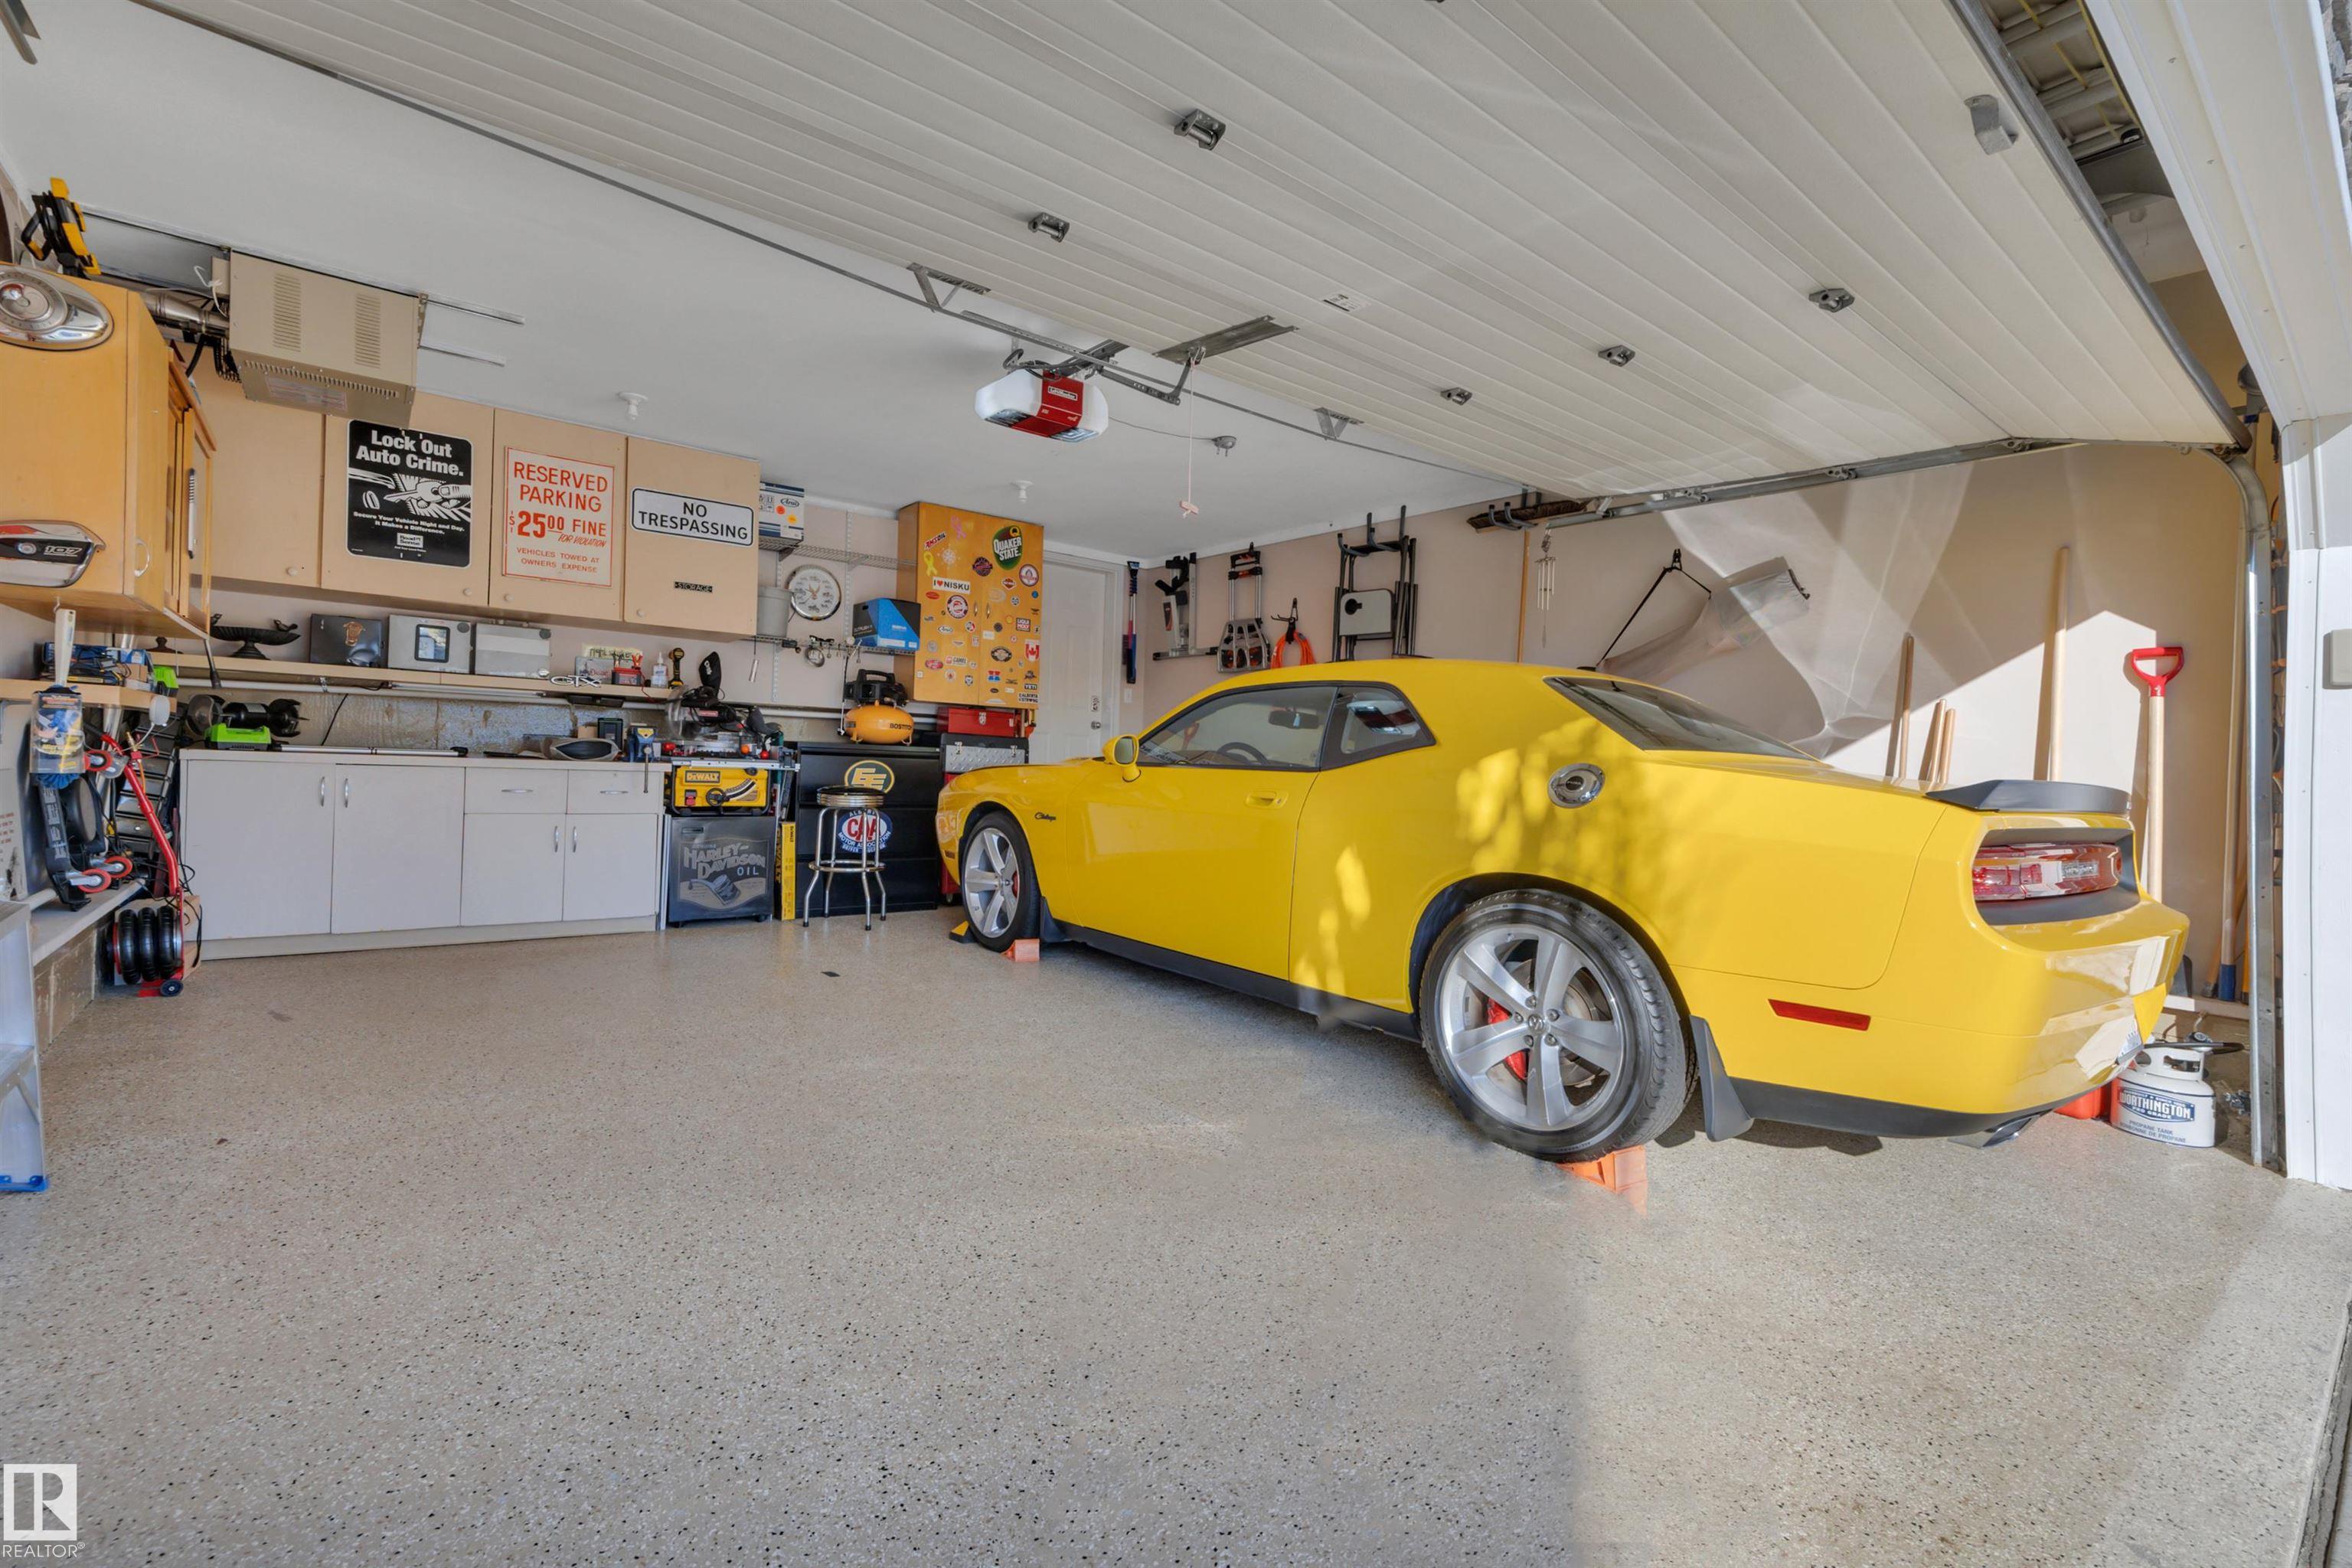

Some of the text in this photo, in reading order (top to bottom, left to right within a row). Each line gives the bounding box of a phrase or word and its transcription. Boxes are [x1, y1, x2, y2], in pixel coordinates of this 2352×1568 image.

[371, 430, 452, 458] Lock Out
[356, 446, 464, 476] Auto Crime.
[514, 461, 608, 492] RESERVED
[520, 484, 602, 512] PARKING
[683, 501, 707, 518] NO
[395, 517, 419, 525] Vehicle
[573, 518, 606, 537] FINE
[639, 511, 748, 540] TRESPASSING
[410, 525, 446, 534] Difference.
[557, 534, 607, 547] FOR VIOLATION
[993, 537, 1022, 554] QUAKER
[516, 547, 556, 557] VEHICLES
[560, 552, 587, 562] TOWED
[521, 557, 597, 573] OWNERS EXPENSE
[943, 581, 969, 591] NISKU
[551, 675, 601, 688] GTX
[697, 854, 766, 880] DAVIDSON
[737, 867, 759, 876] OIL
[2119, 1091, 2190, 1119] WORTHINGTON
[2147, 1111, 2172, 1119] GRADE
[2129, 1120, 2154, 1131] PROPANE
[2158, 1132, 2186, 1142] PROPANE
